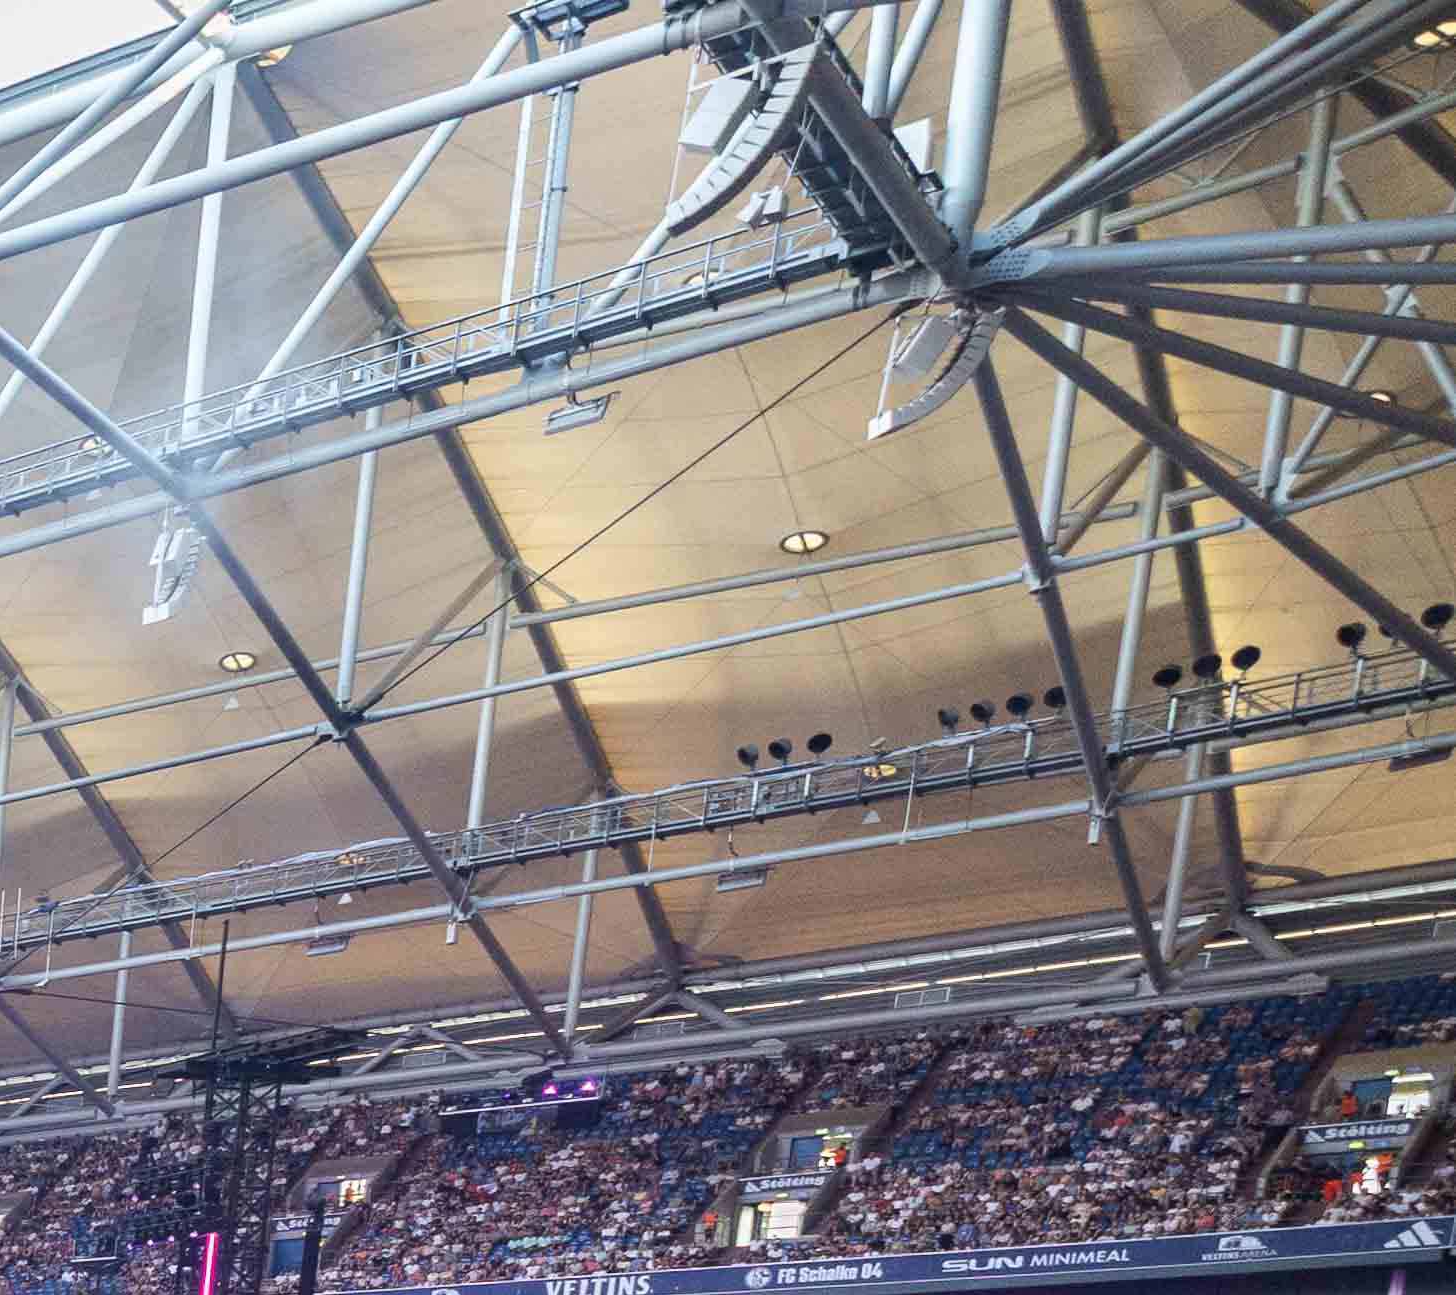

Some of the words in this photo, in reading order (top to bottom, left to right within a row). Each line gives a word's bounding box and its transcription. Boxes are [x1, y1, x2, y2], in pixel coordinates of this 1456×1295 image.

[941, 1255, 1025, 1273] SUN
[1029, 1248, 1131, 1267] MINIMEAL
[777, 1268, 797, 1284] FC
[860, 1262, 883, 1279] 04
